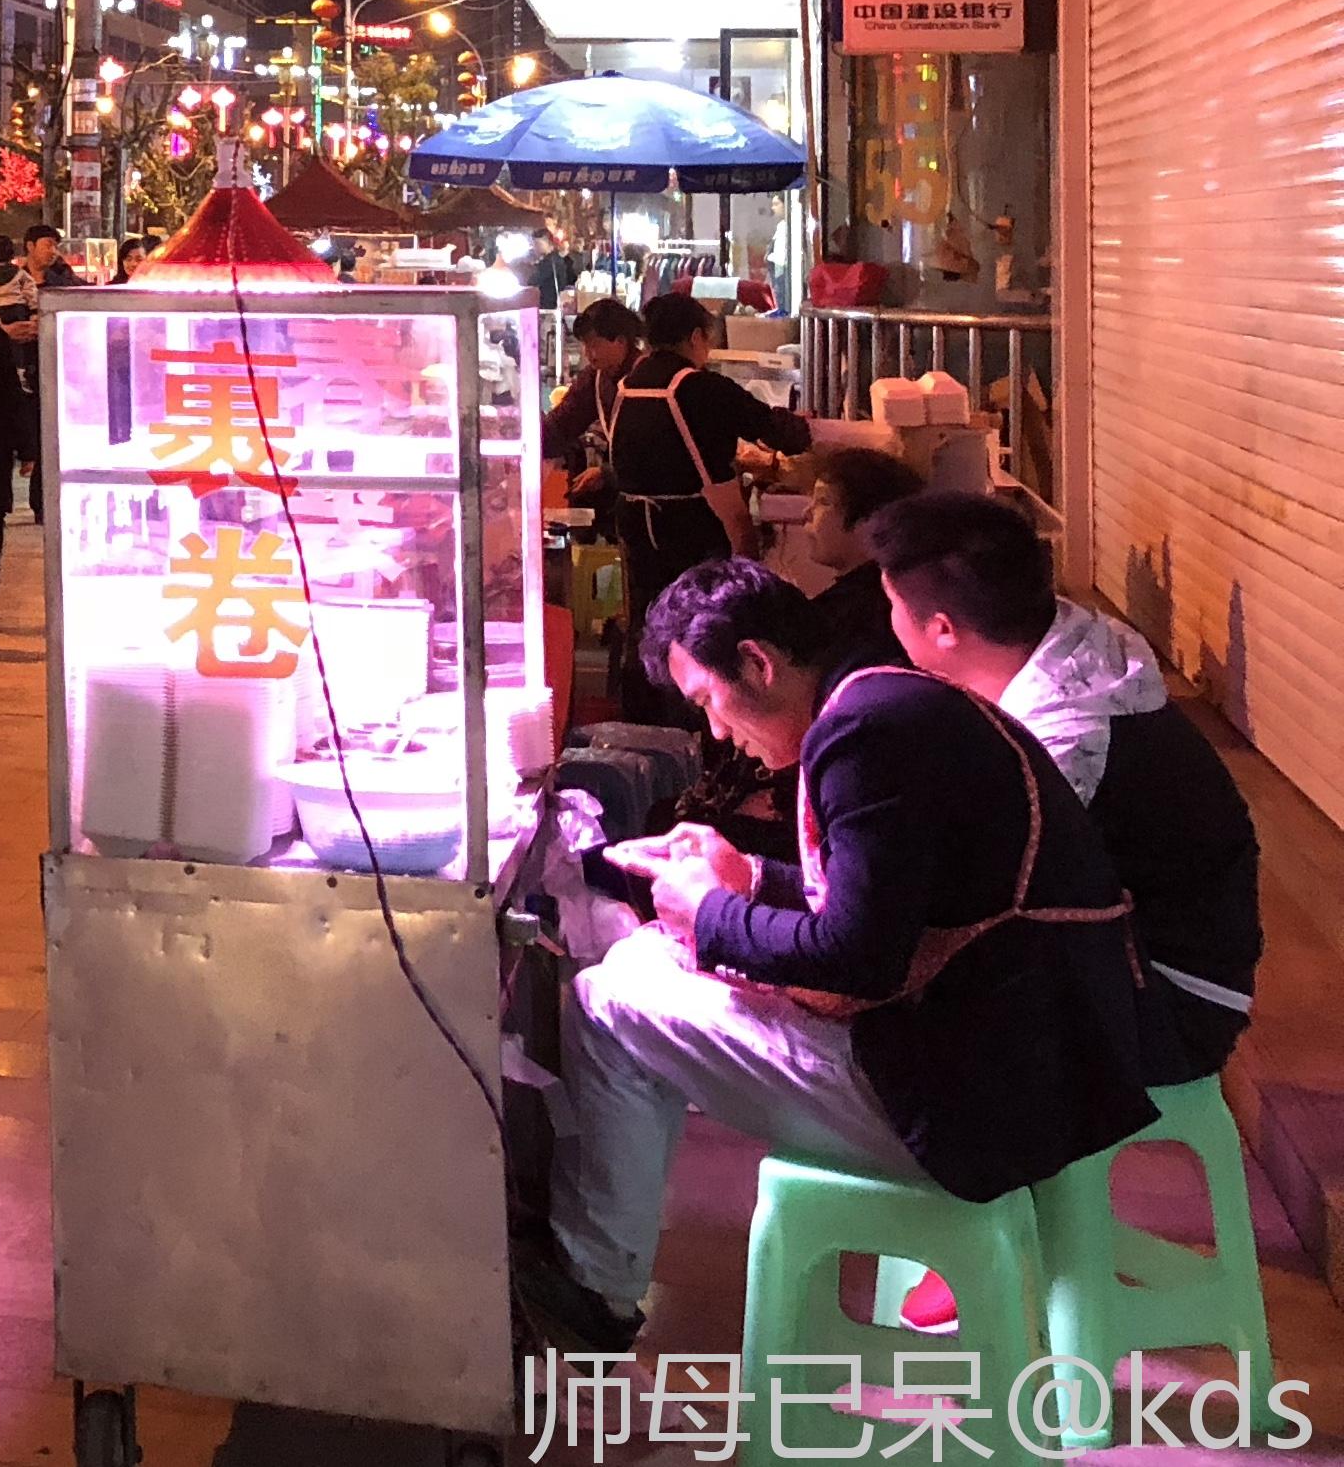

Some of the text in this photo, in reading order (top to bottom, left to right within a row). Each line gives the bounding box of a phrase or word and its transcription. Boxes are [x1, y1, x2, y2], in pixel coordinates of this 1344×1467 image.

[853, 2, 1012, 20] 中国建设银行
[864, 20, 1002, 31] China Construction Bank
